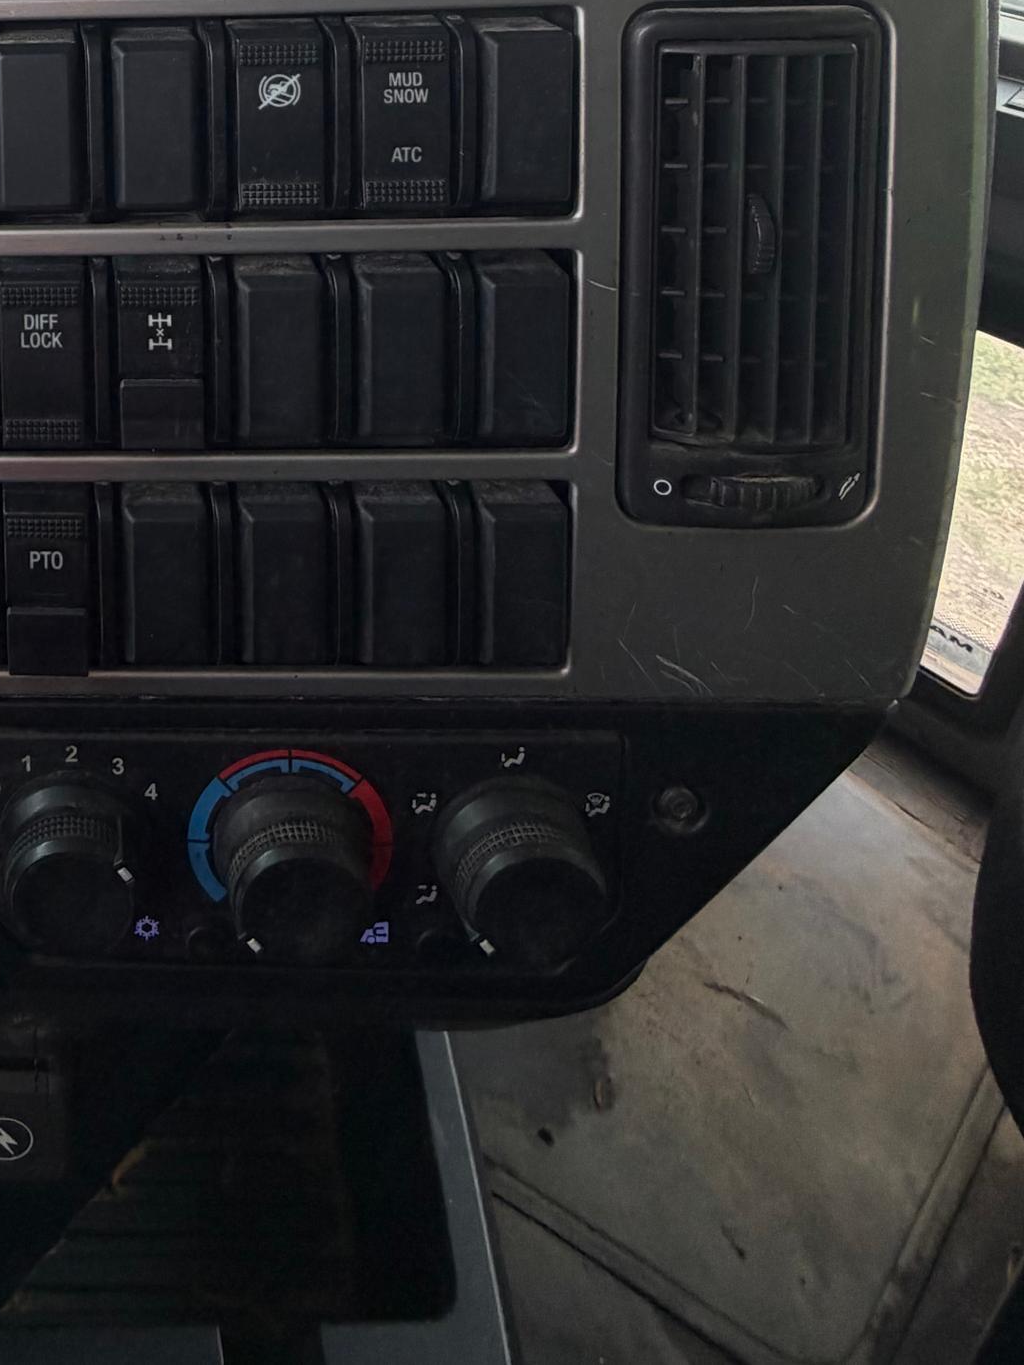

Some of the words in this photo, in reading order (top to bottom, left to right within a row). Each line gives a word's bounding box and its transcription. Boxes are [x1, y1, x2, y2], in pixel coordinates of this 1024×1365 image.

[388, 72, 423, 87] MUD
[383, 88, 429, 104] SNOW
[391, 146, 422, 163] ATC
[24, 314, 58, 330] DIFF
[20, 332, 63, 348] LOCK
[29, 550, 64, 570] PTO
[65, 745, 78, 763] 2
[21, 755, 31, 772] 1
[111, 757, 124, 775] 3
[144, 783, 158, 800] 4
